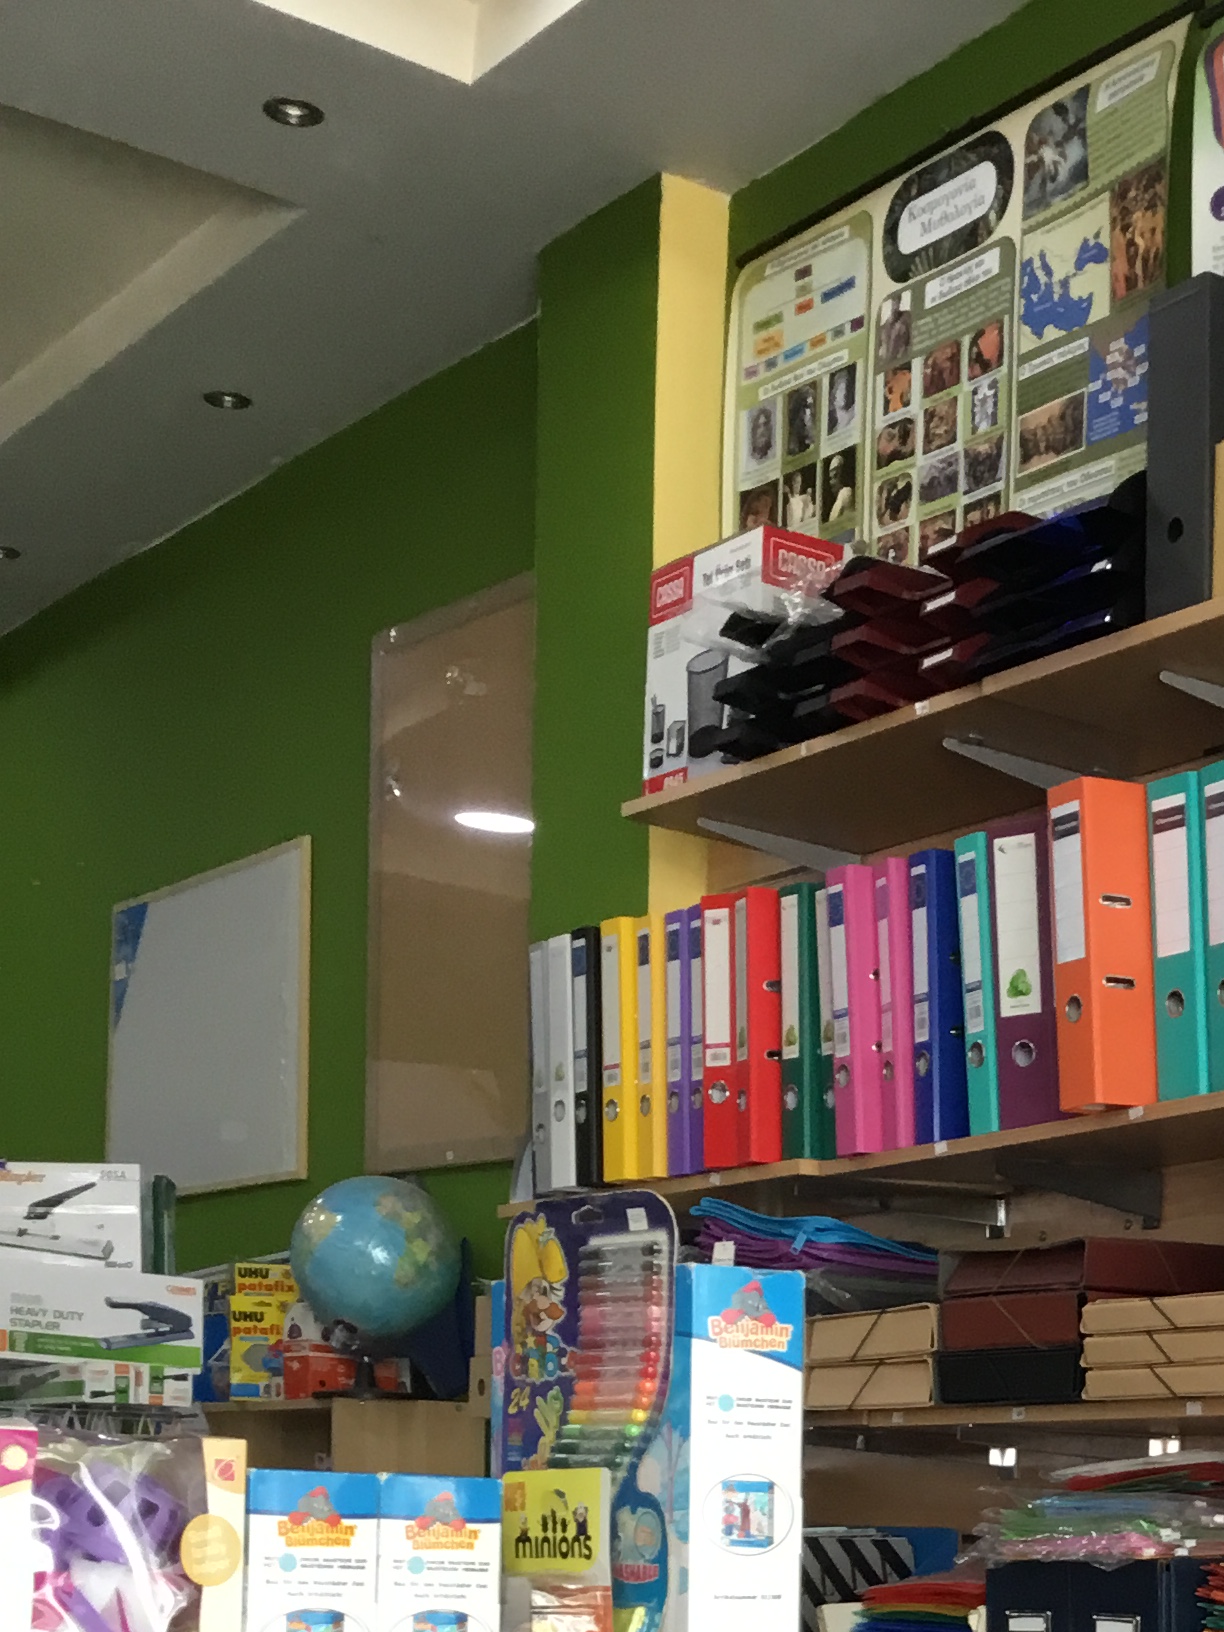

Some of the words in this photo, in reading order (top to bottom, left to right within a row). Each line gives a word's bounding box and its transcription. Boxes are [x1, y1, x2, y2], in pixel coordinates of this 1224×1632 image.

[237, 1267, 270, 1279] UHU
[237, 1280, 295, 1294] patafix
[9, 1305, 50, 1320] HEAVY
[52, 1309, 85, 1322] DUTY
[232, 1310, 265, 1323] UHU
[9, 1317, 61, 1331] STAPLER
[232, 1324, 283, 1337] patafi
[709, 1317, 791, 1338] Benjamin
[718, 1336, 786, 1350] Blümchen
[507, 1386, 531, 1415] 24
[277, 1519, 357, 1538] Benjamin
[405, 1523, 480, 1541] Benjamin
[285, 1535, 352, 1547] Blümchen
[412, 1539, 475, 1551] Blümchen
[514, 1534, 593, 1560] minions
